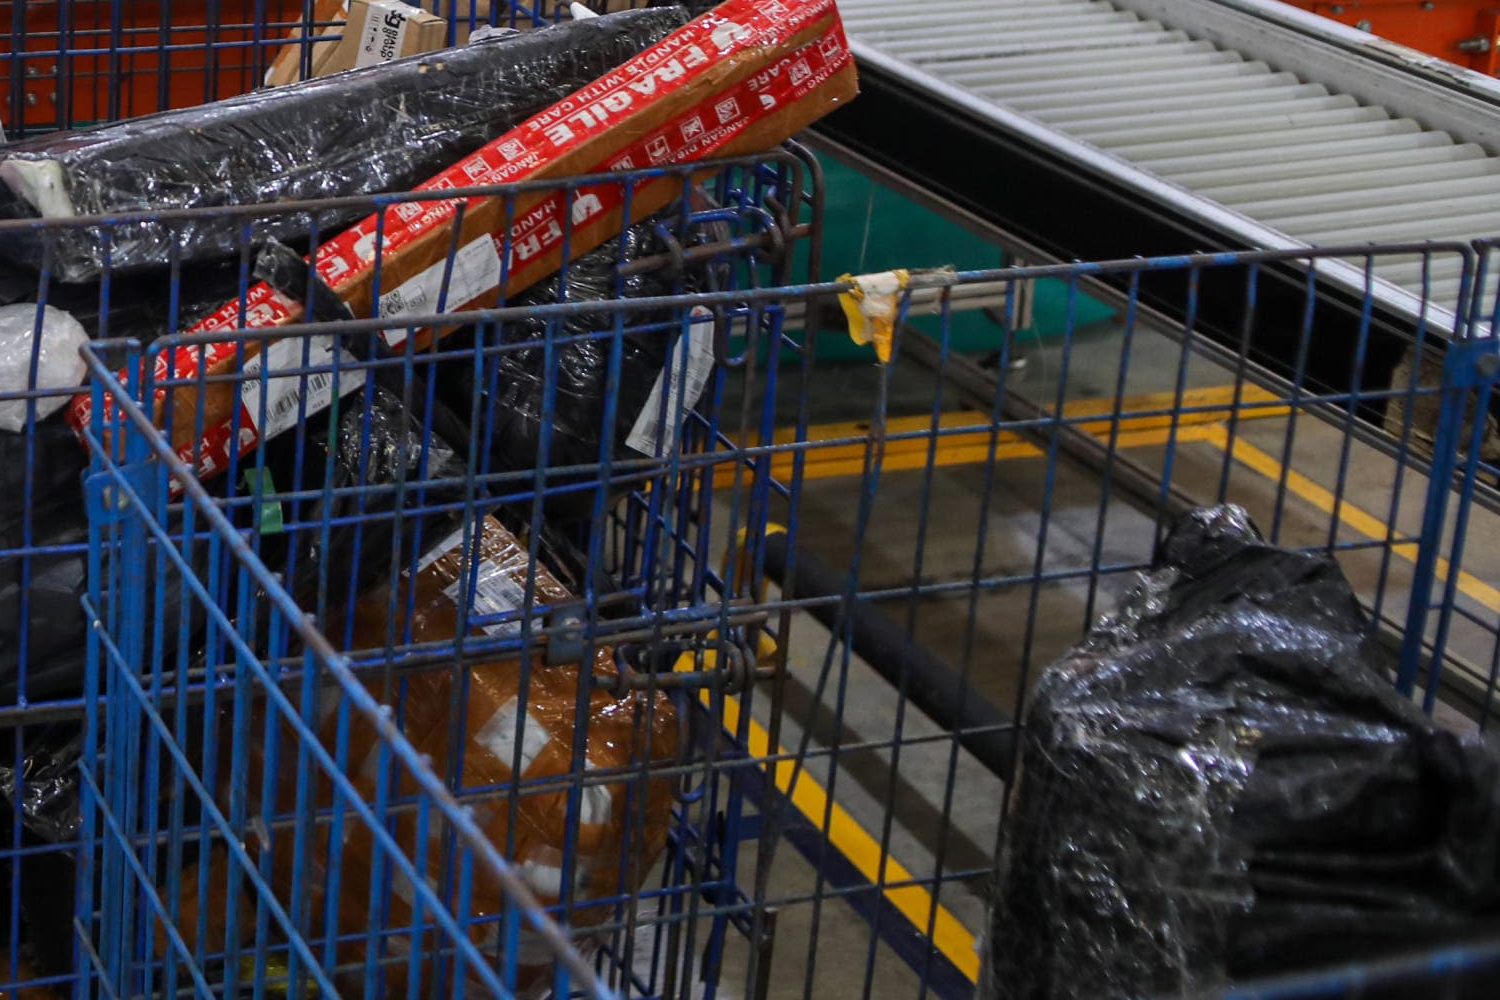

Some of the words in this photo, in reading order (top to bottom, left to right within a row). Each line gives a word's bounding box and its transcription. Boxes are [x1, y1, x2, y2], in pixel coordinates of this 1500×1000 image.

[623, 27, 696, 76] HANDLE
[544, 41, 708, 149] FRAGILE
[576, 71, 624, 104] WITH
[526, 98, 574, 132] CARE
